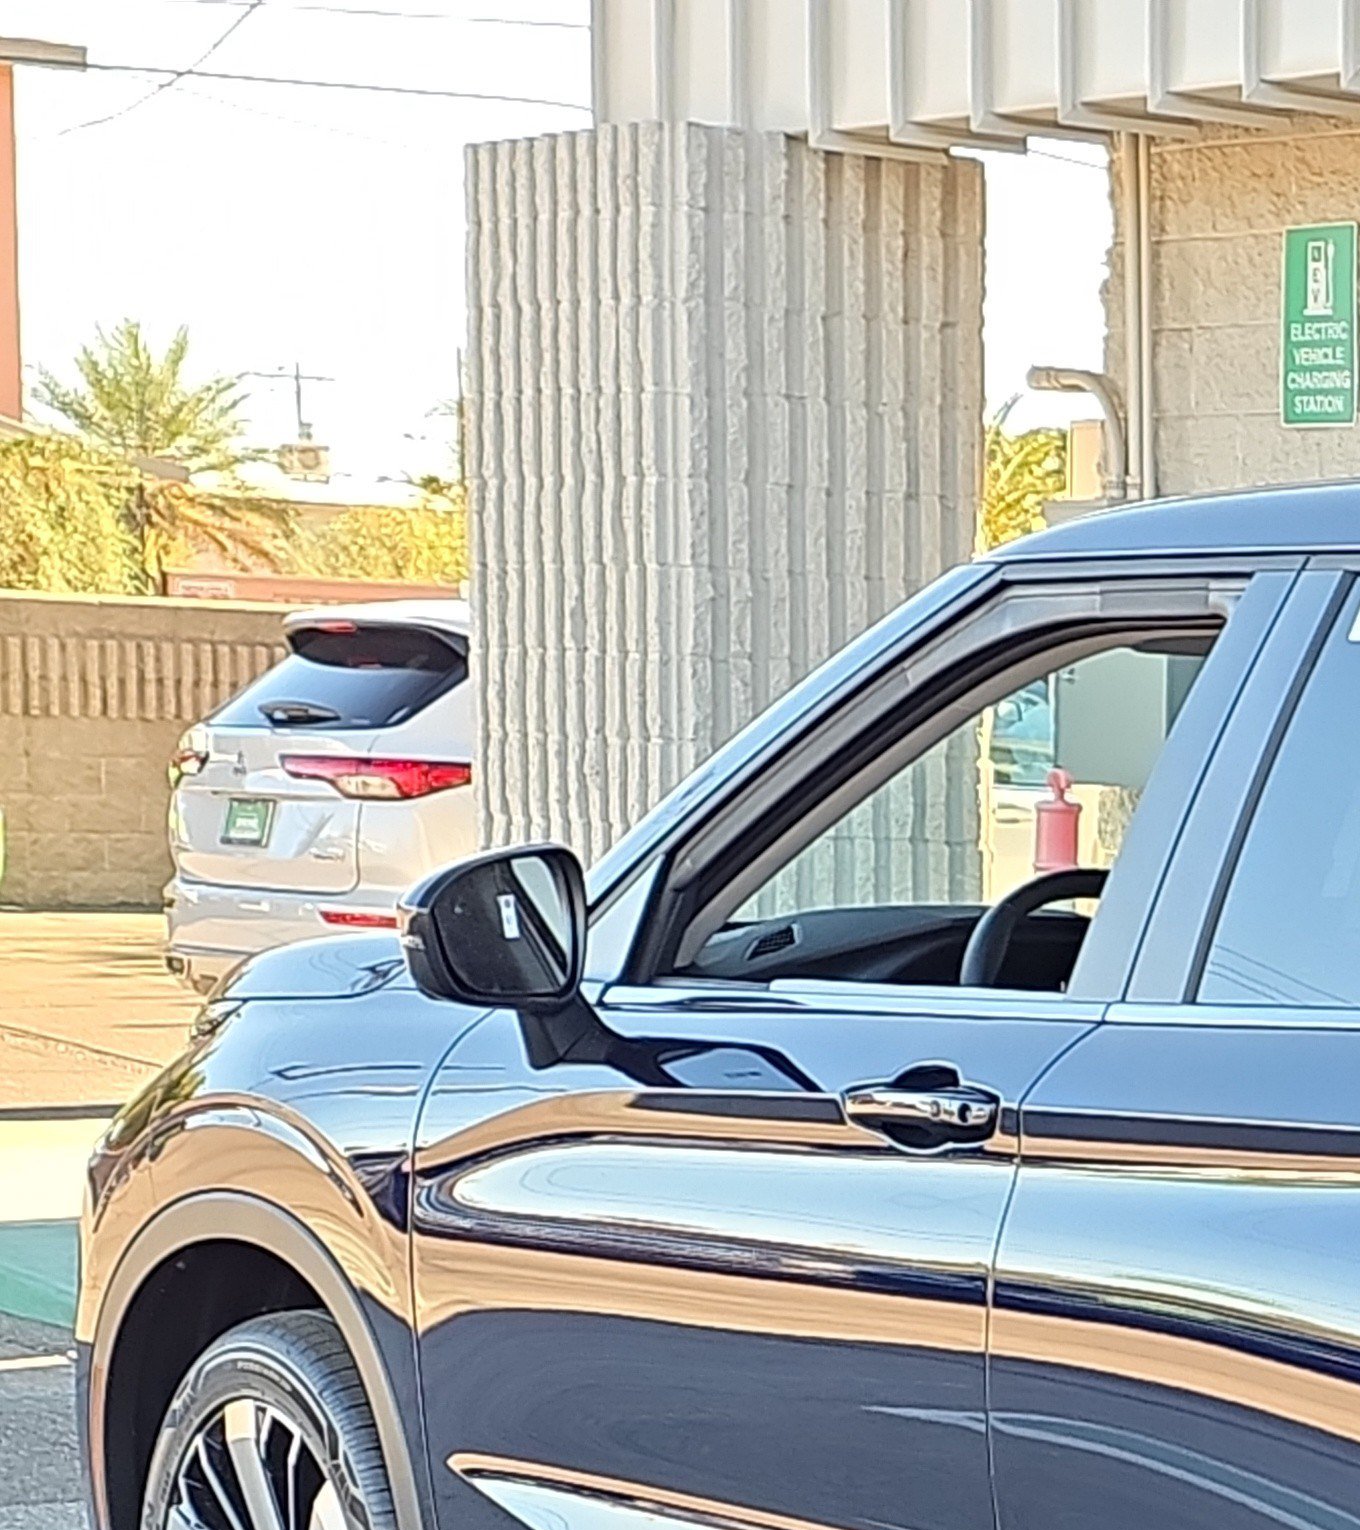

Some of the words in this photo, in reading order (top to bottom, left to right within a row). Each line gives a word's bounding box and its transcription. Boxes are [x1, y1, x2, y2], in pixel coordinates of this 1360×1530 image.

[1290, 321, 1350, 342] ELECTRIC
[1292, 346, 1346, 366] VEHICLE
[1286, 371, 1352, 390] CHARGING
[1294, 395, 1345, 414] STATION
